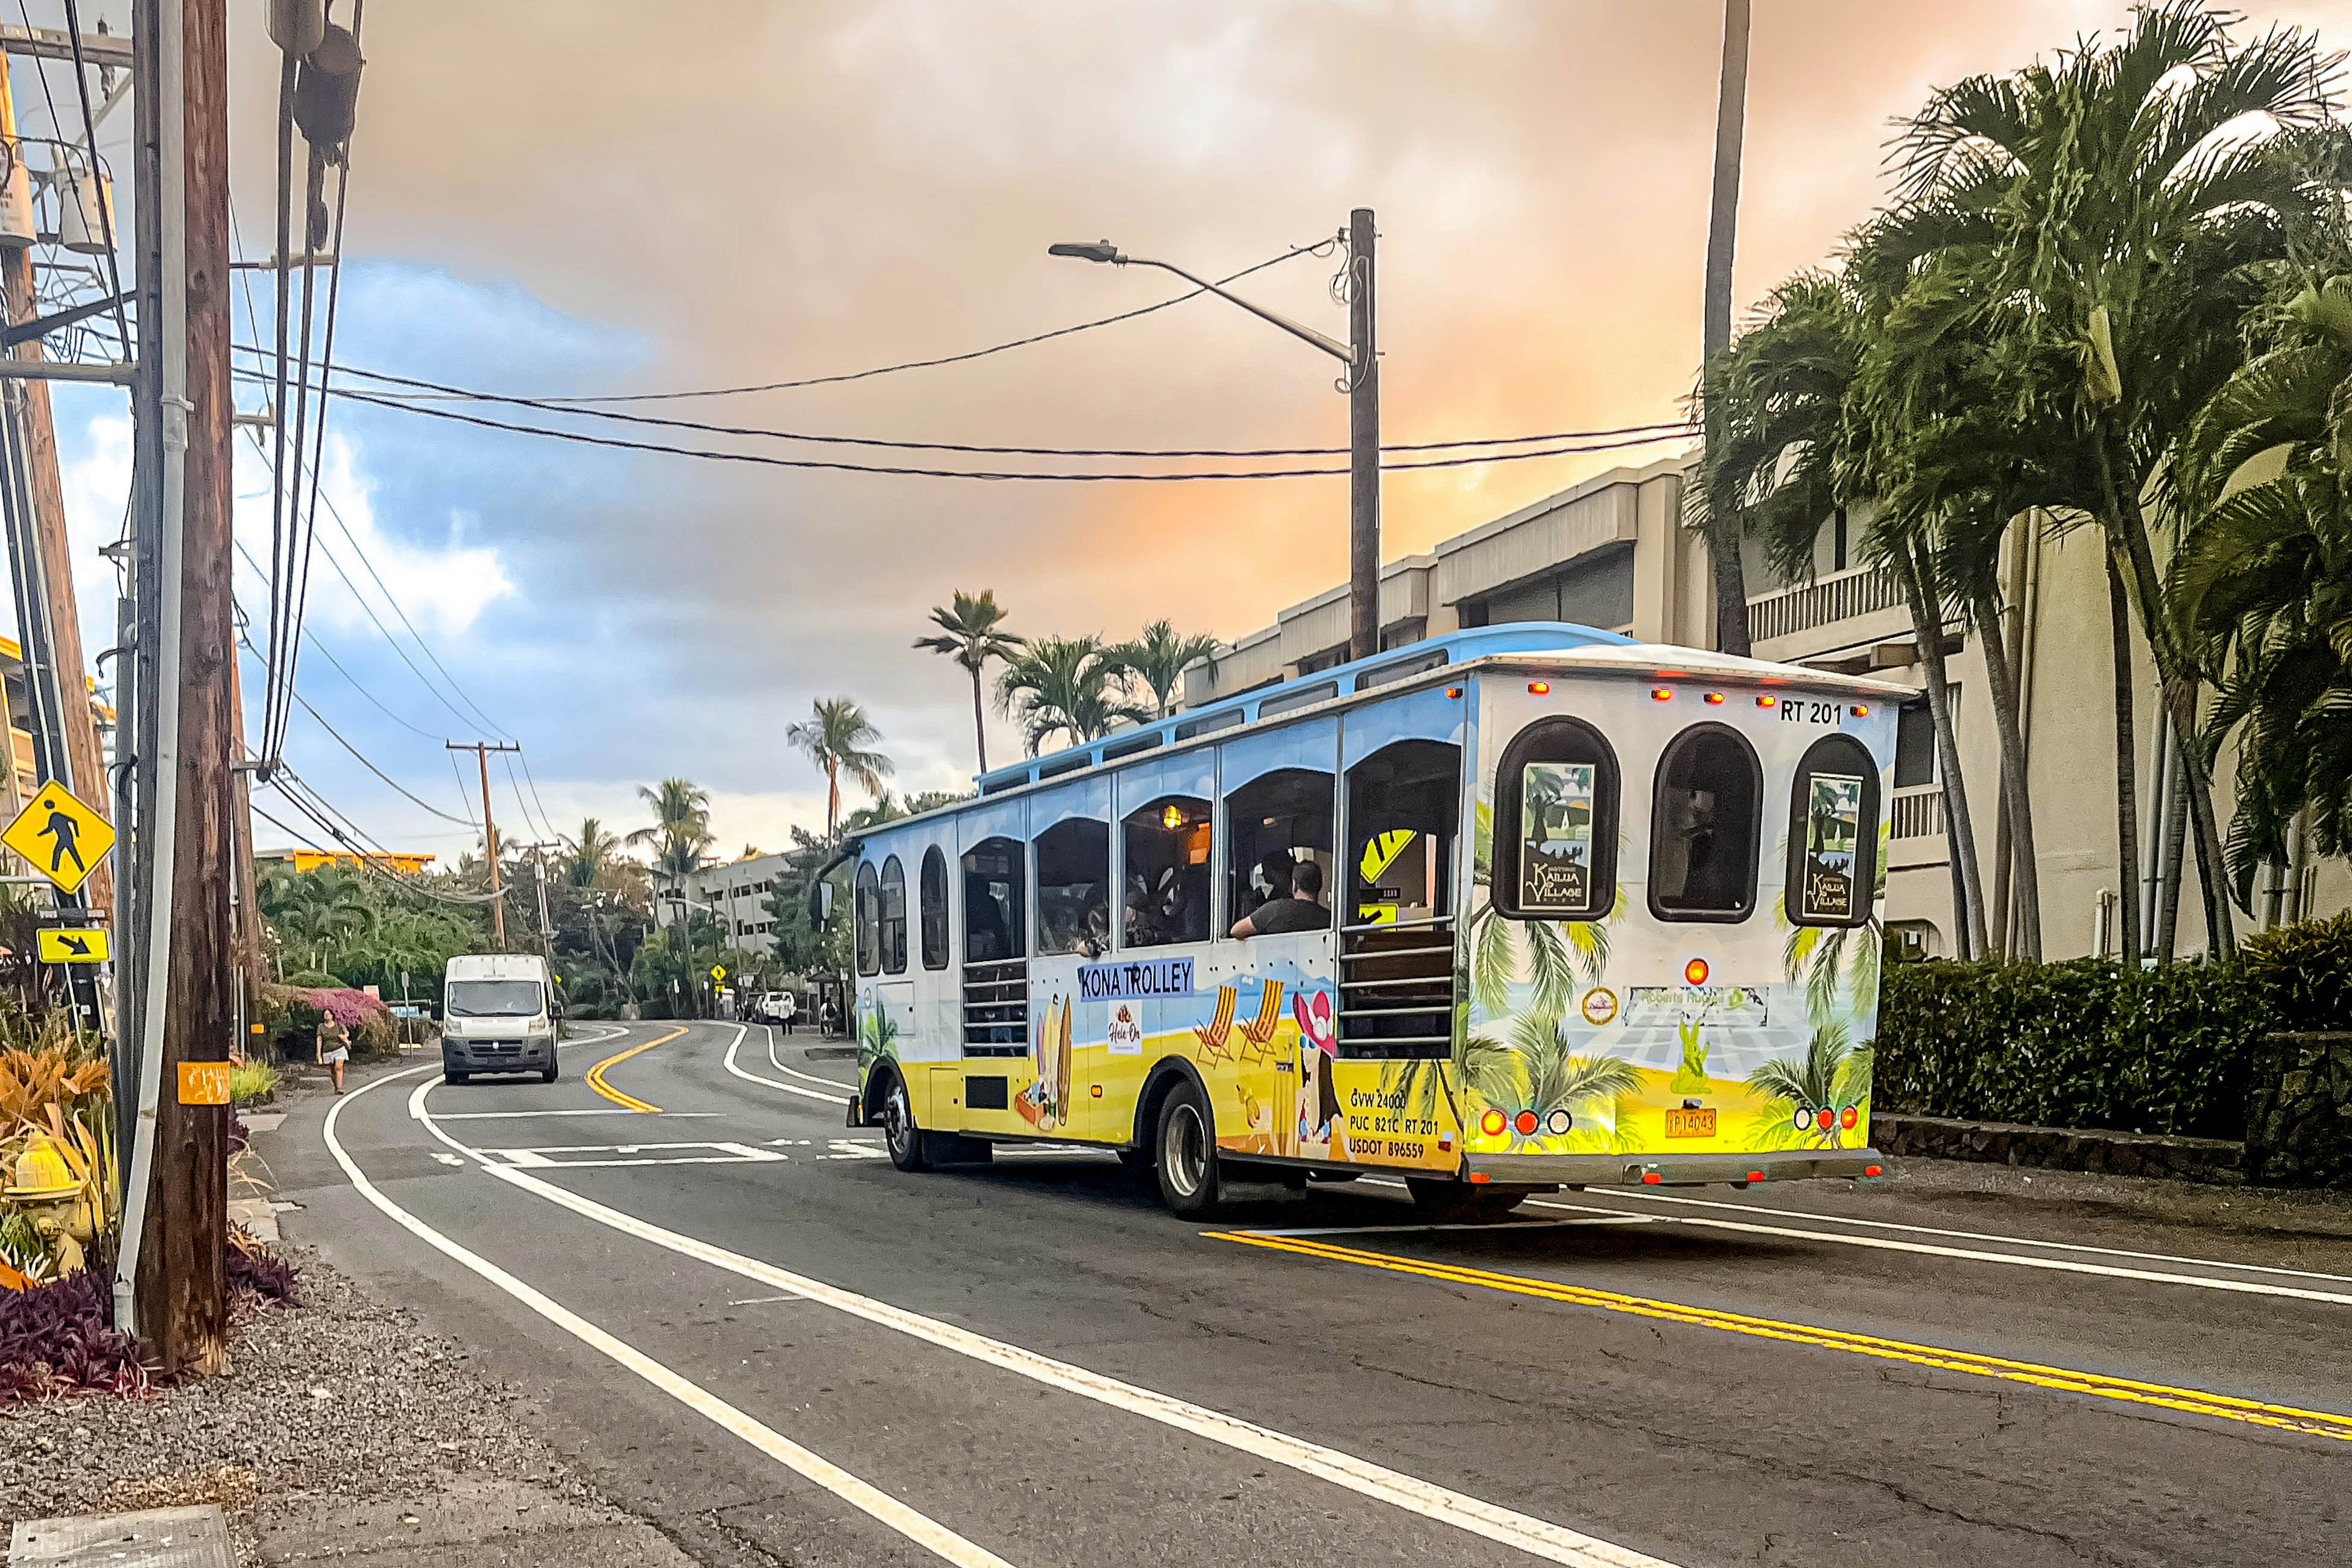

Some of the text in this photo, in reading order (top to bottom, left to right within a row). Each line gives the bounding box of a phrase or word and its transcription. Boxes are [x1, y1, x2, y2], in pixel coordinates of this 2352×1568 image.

[1781, 700, 1841, 725] RT 201
[1532, 862, 1580, 886] KAILUA
[1525, 880, 1582, 902] VILLAGE
[1081, 962, 1192, 997] KONA TROLLEY
[1351, 1090, 1406, 1110] GVW 24000
[1350, 1115, 1438, 1136] PUC 821C RT 201
[1349, 1137, 1424, 1159] USDOT 896559
